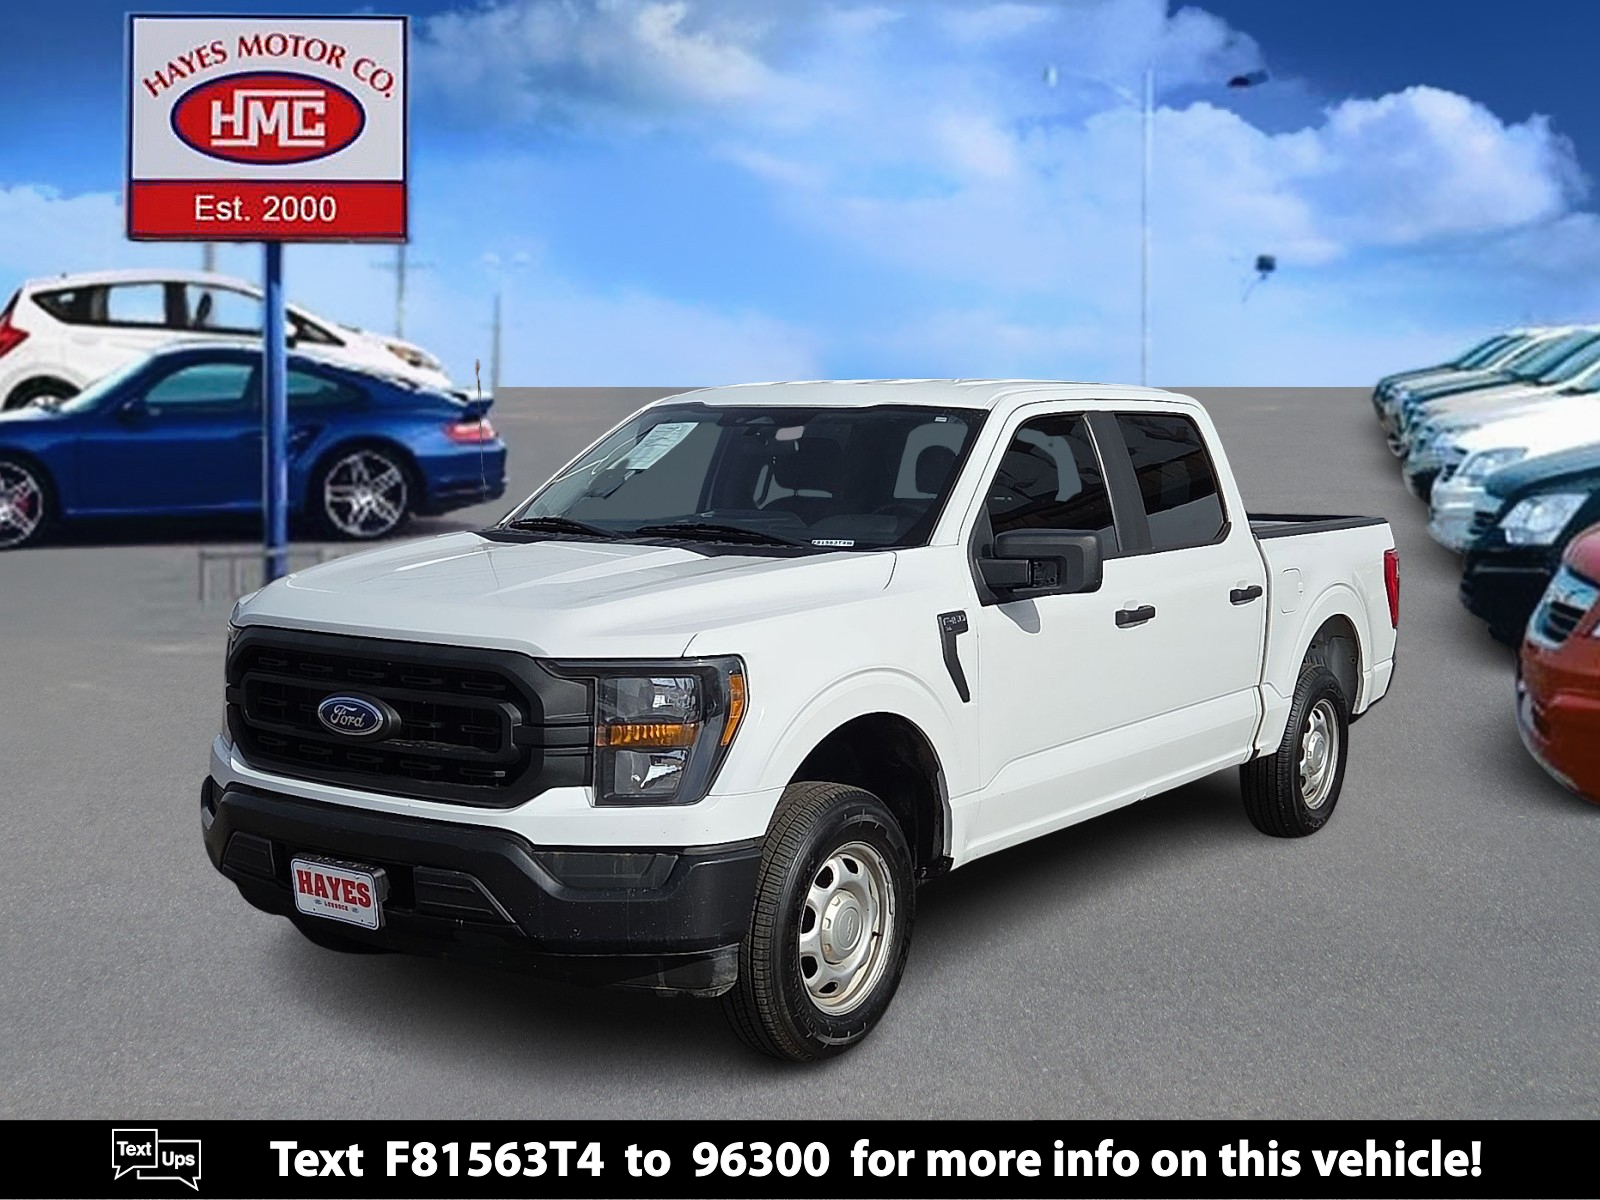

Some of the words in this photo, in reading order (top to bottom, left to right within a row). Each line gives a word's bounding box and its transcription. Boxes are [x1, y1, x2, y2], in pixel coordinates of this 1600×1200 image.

[143, 41, 227, 97] HAYES
[238, 33, 346, 69] MOTOR
[353, 58, 394, 98] CO.
[211, 89, 325, 147] HMC
[195, 195, 250, 222] Est.
[262, 196, 337, 222] 2000
[330, 704, 366, 728] Ford
[296, 869, 372, 908] HAYES
